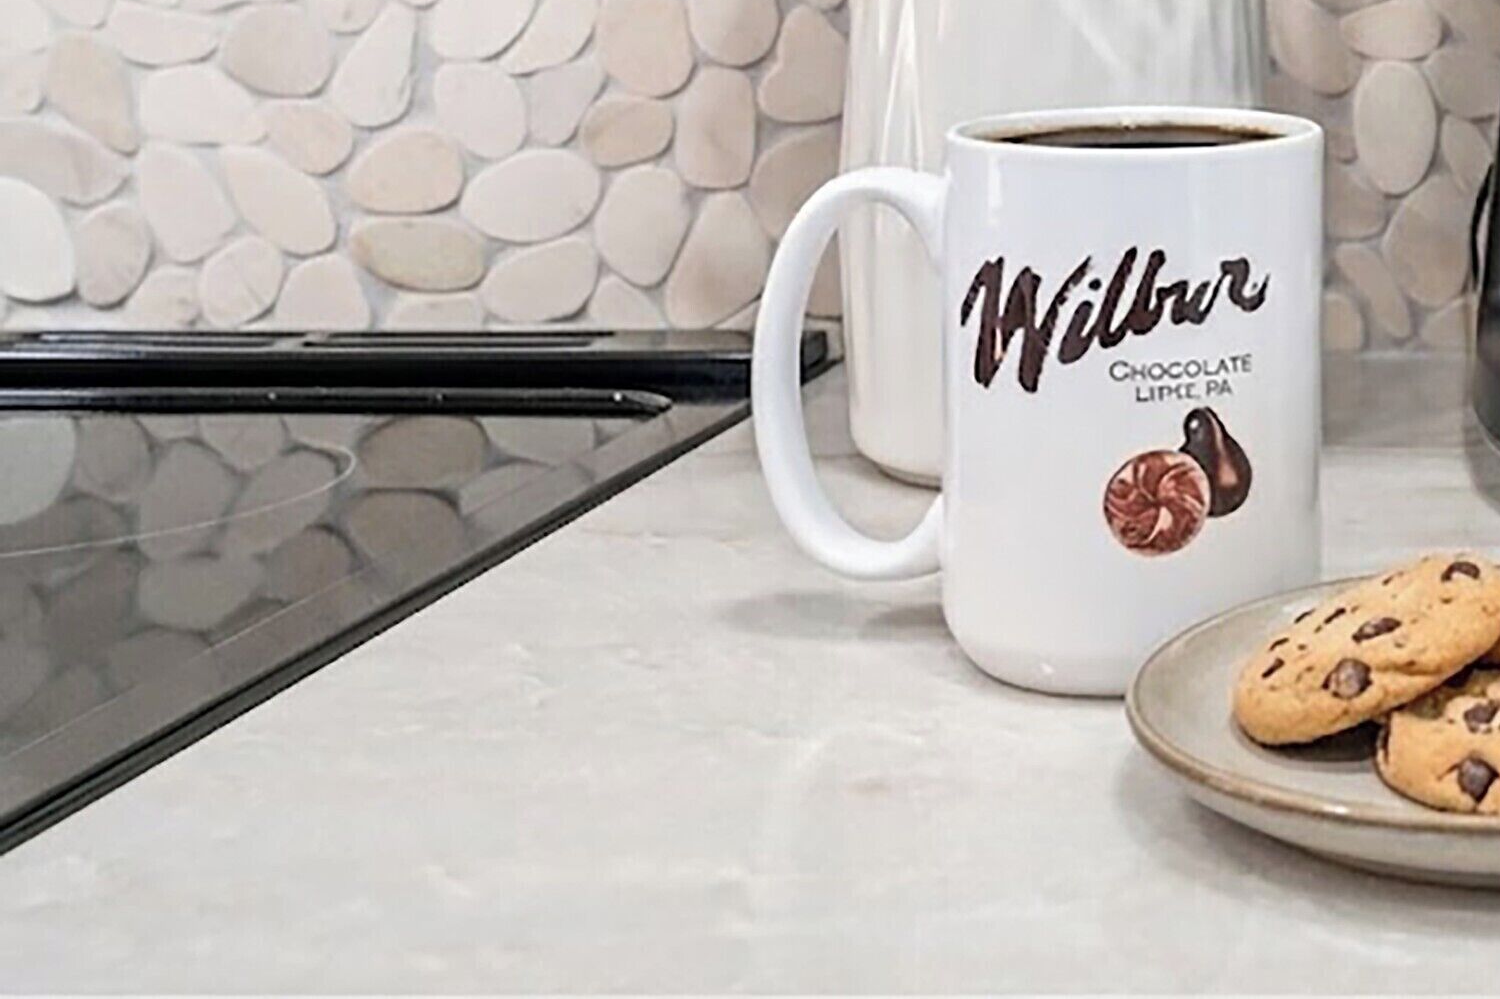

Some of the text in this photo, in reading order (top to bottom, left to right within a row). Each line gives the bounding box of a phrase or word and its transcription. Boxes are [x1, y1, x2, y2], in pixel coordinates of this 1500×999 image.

[960, 246, 1270, 394] Wilbur
[1109, 353, 1253, 382] CHOCOLATE
[1204, 379, 1233, 397] PA
